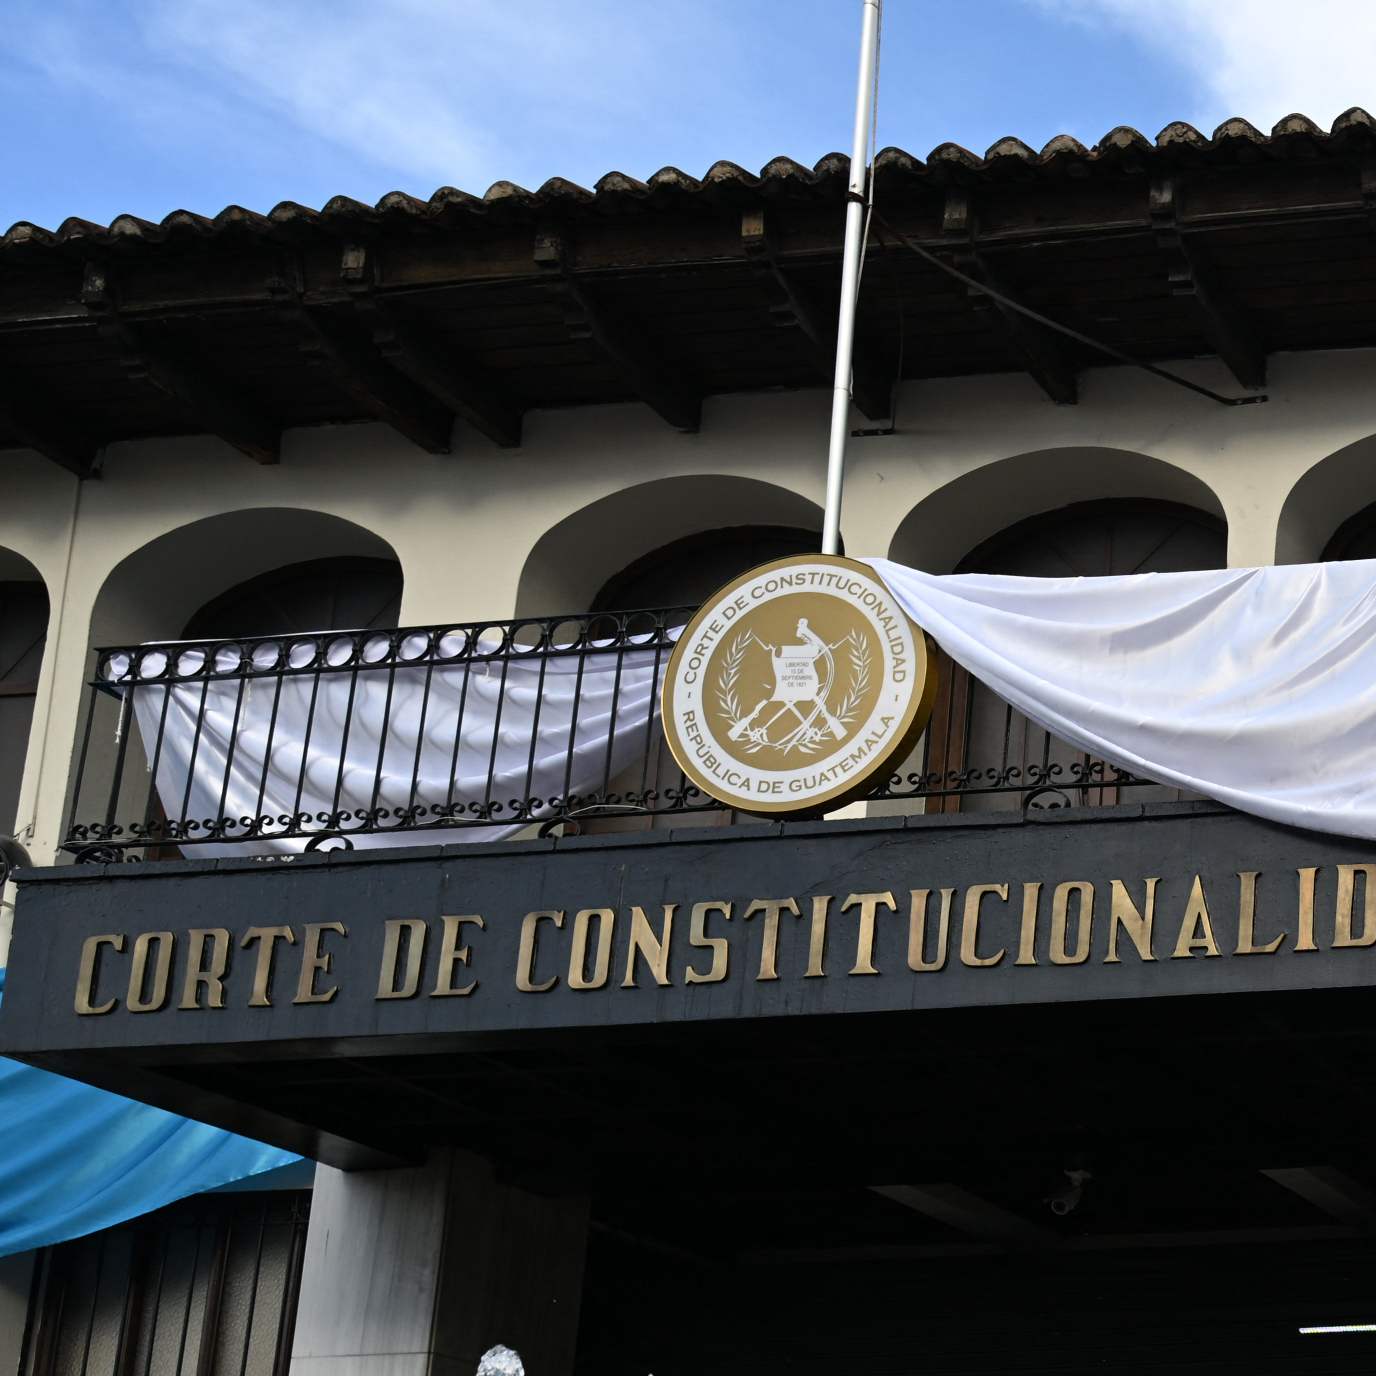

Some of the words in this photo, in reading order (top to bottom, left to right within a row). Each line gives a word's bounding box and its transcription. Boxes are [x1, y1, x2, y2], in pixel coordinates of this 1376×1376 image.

[684, 619, 723, 685] CORTE
[723, 595, 749, 620] DE
[751, 572, 906, 683] CONSTITUCIONALIDAD
[683, 710, 750, 792] REPÚBLICA
[757, 780, 784, 793] DE
[788, 715, 896, 793] GUATEMALA
[73, 920, 348, 1016] CORTE
[375, 913, 485, 999] DE
